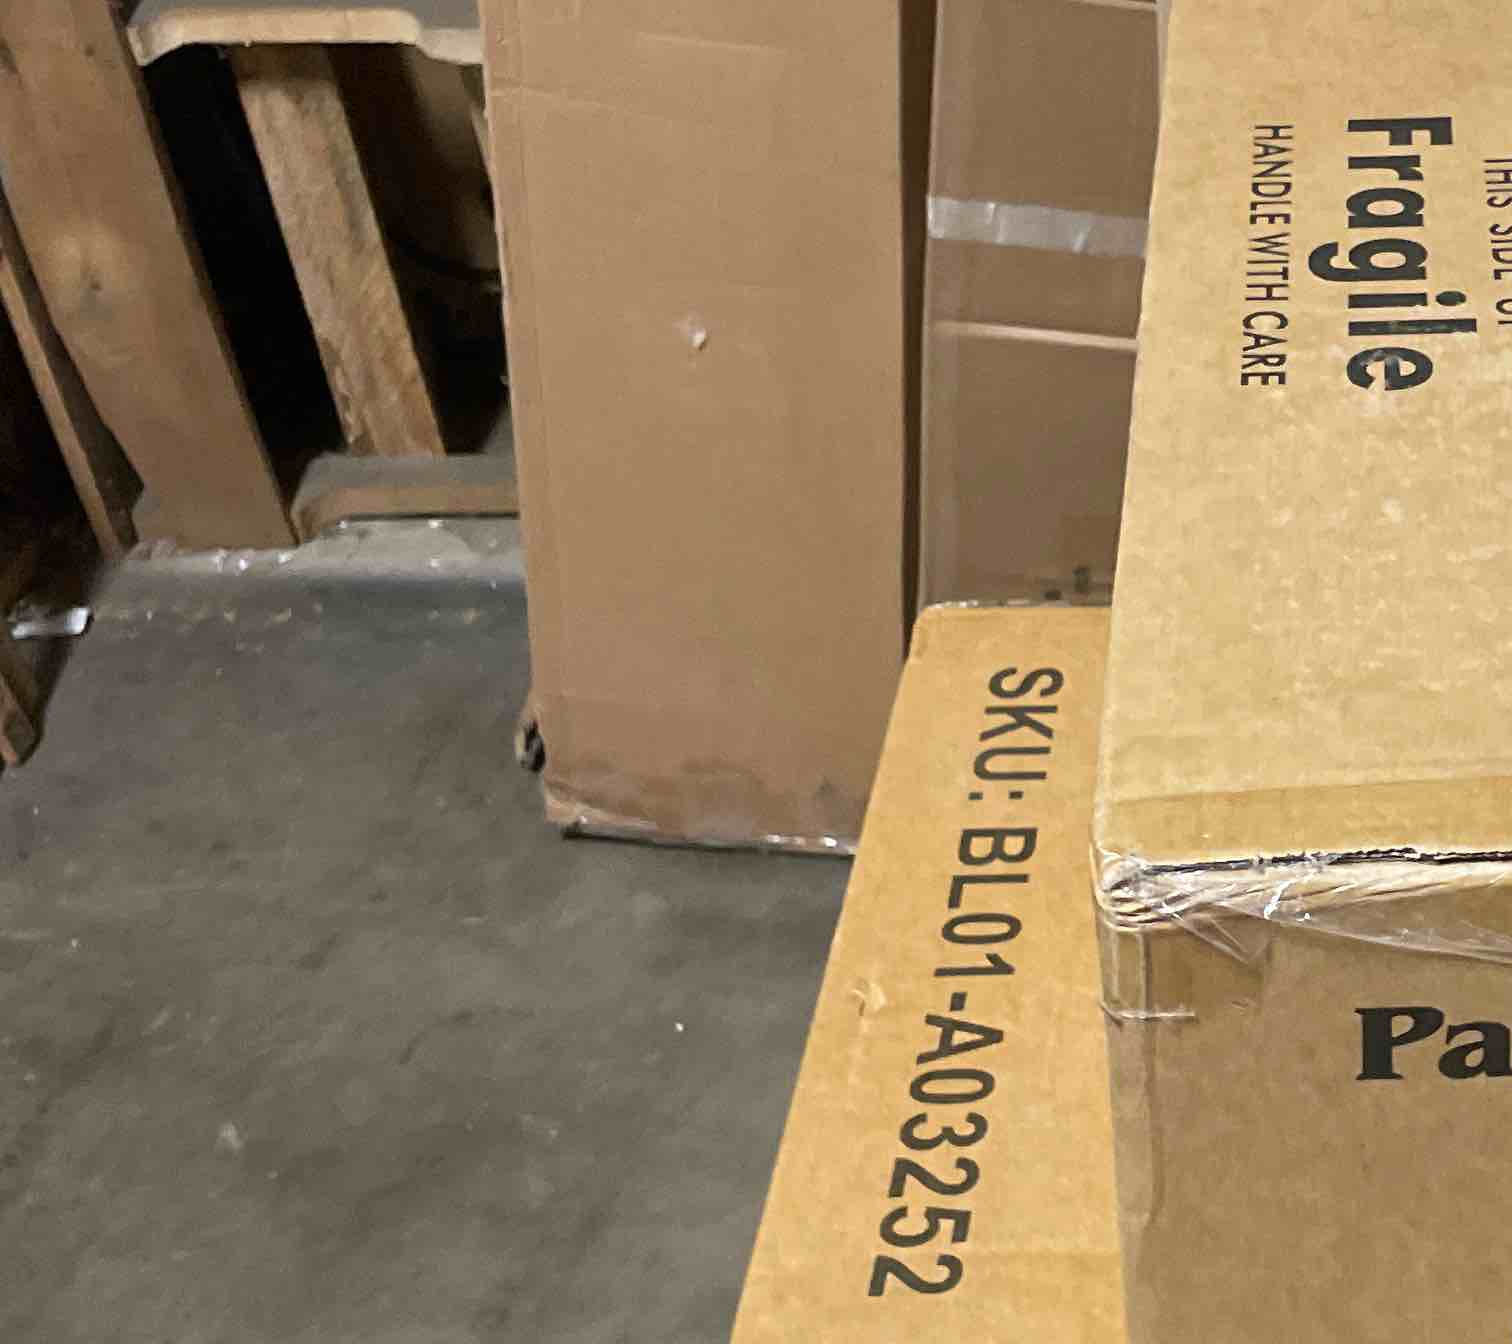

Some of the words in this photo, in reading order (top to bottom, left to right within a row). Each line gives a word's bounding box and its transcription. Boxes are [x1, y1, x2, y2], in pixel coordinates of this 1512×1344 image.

[1248, 125, 1293, 226] HANDLE
[1245, 233, 1290, 302] WITH
[1308, 116, 1477, 392] Fragile
[1240, 311, 1290, 387] CARE
[967, 667, 1064, 801] SKU:
[867, 827, 1039, 1298] BL01-A03252
